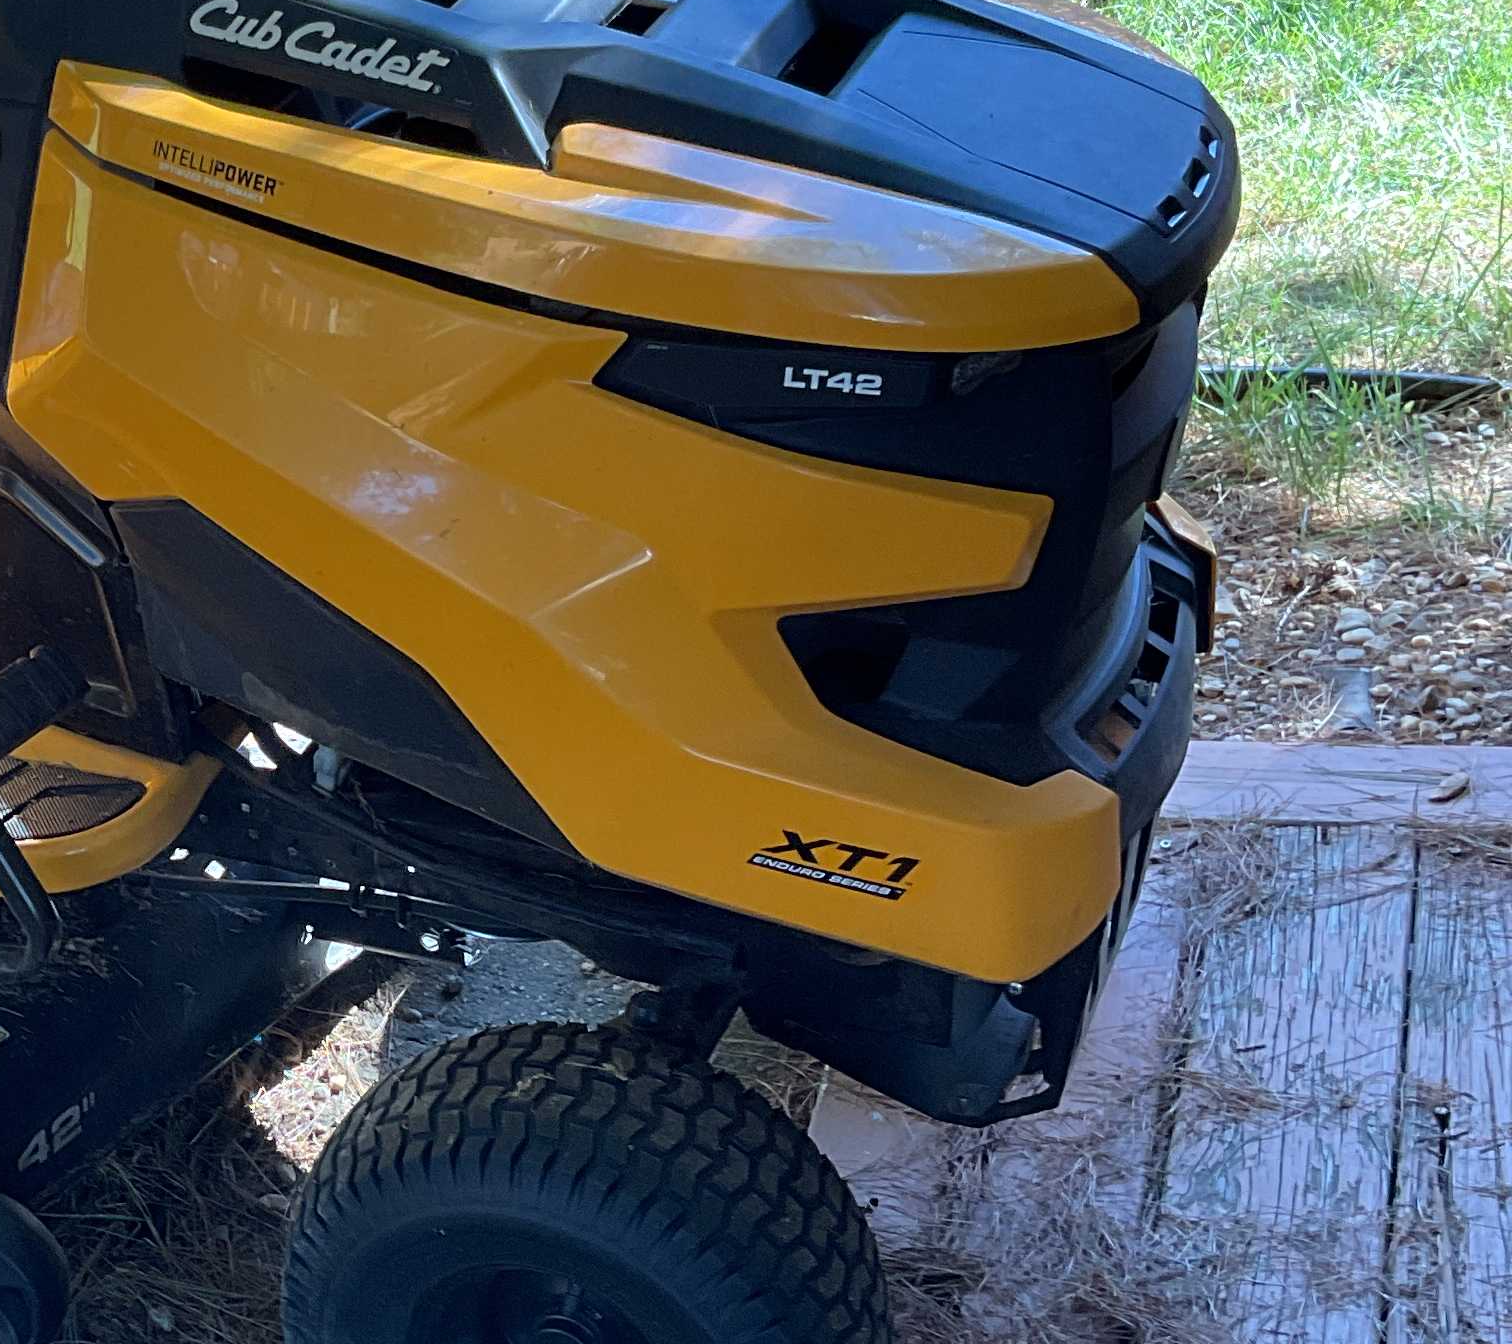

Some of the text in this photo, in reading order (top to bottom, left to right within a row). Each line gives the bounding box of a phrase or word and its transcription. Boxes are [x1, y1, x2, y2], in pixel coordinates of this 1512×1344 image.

[284, 20, 451, 93] Cadet
[152, 139, 278, 196] INTELLIPOWER
[783, 366, 883, 396] LT42
[752, 855, 892, 896] ENDURO SERIES
[760, 829, 920, 883] XT1
